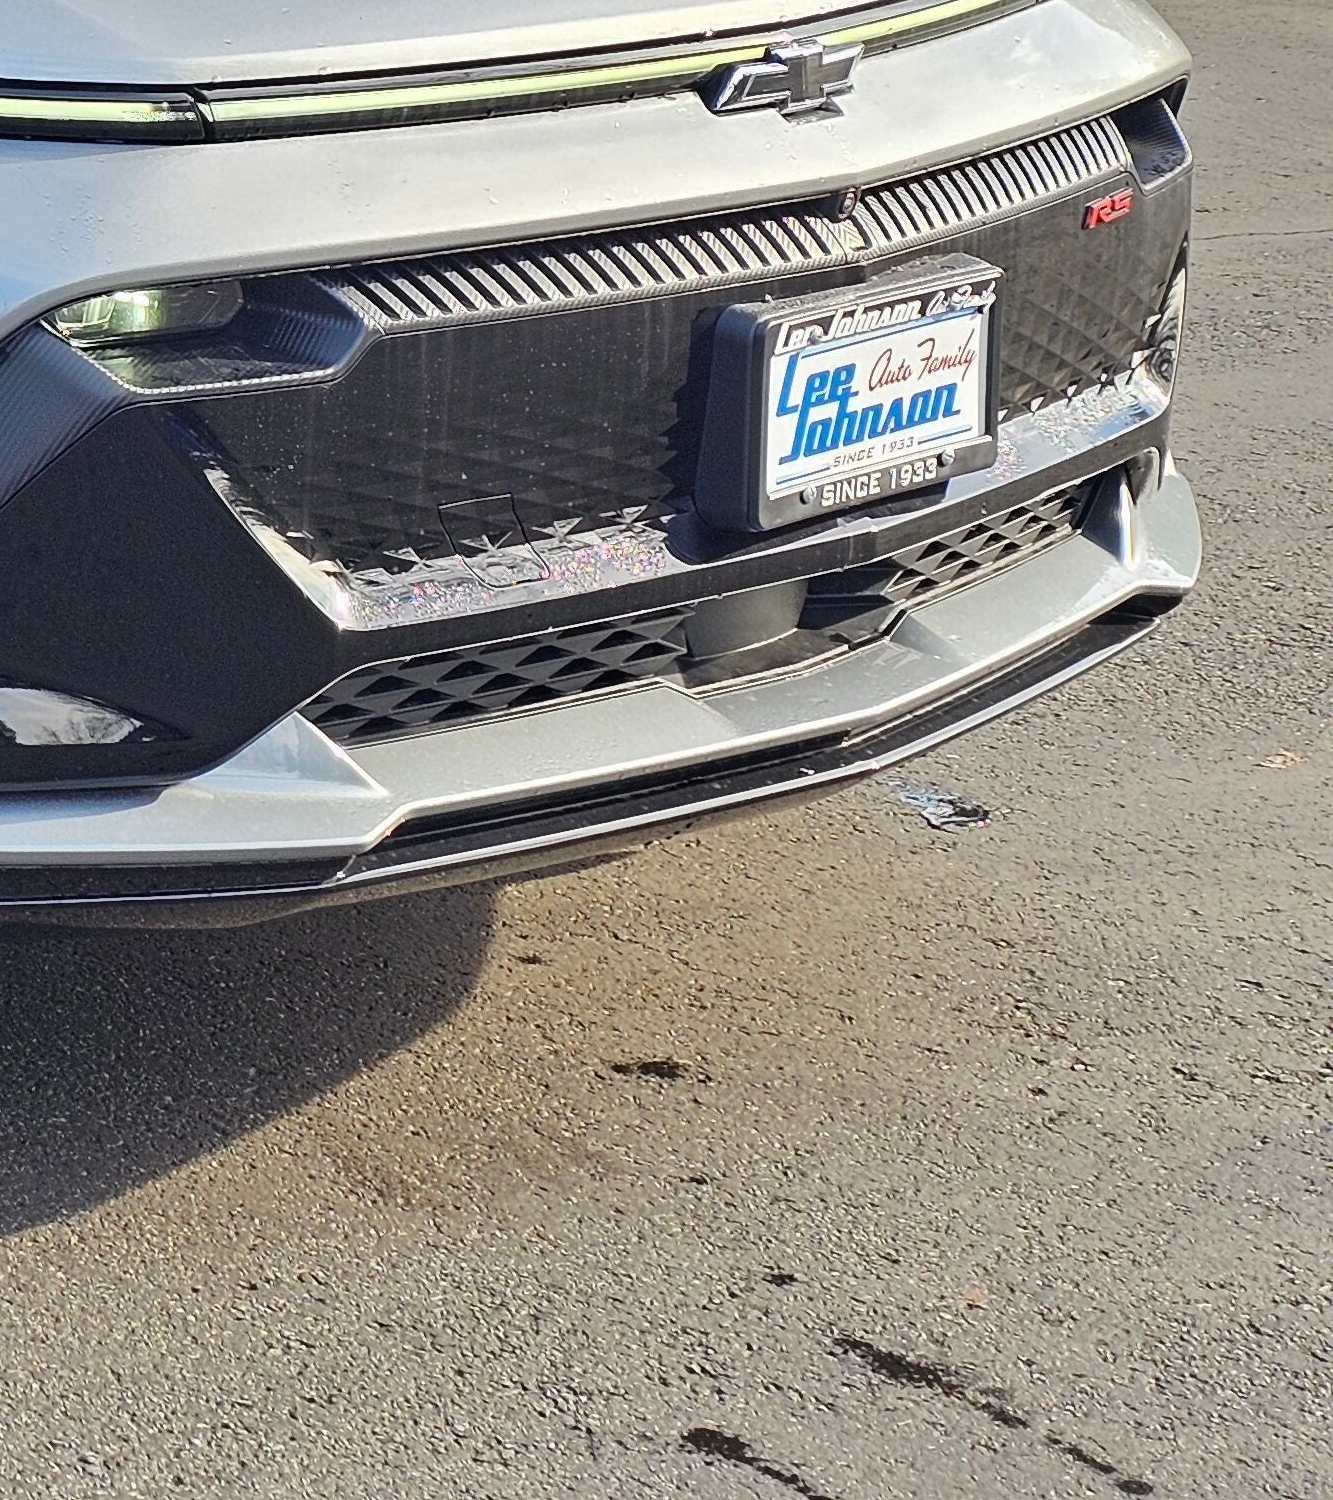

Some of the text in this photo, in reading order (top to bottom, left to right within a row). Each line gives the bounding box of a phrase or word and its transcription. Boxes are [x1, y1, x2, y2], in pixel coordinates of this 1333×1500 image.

[1083, 187, 1134, 230] RS
[821, 300, 922, 342] Johnson
[776, 352, 857, 417] Lee
[868, 328, 978, 391] Auto Family
[778, 381, 962, 465] Johnson
[833, 437, 915, 467] SINCE 1933
[821, 457, 938, 507] SINCE 1933
